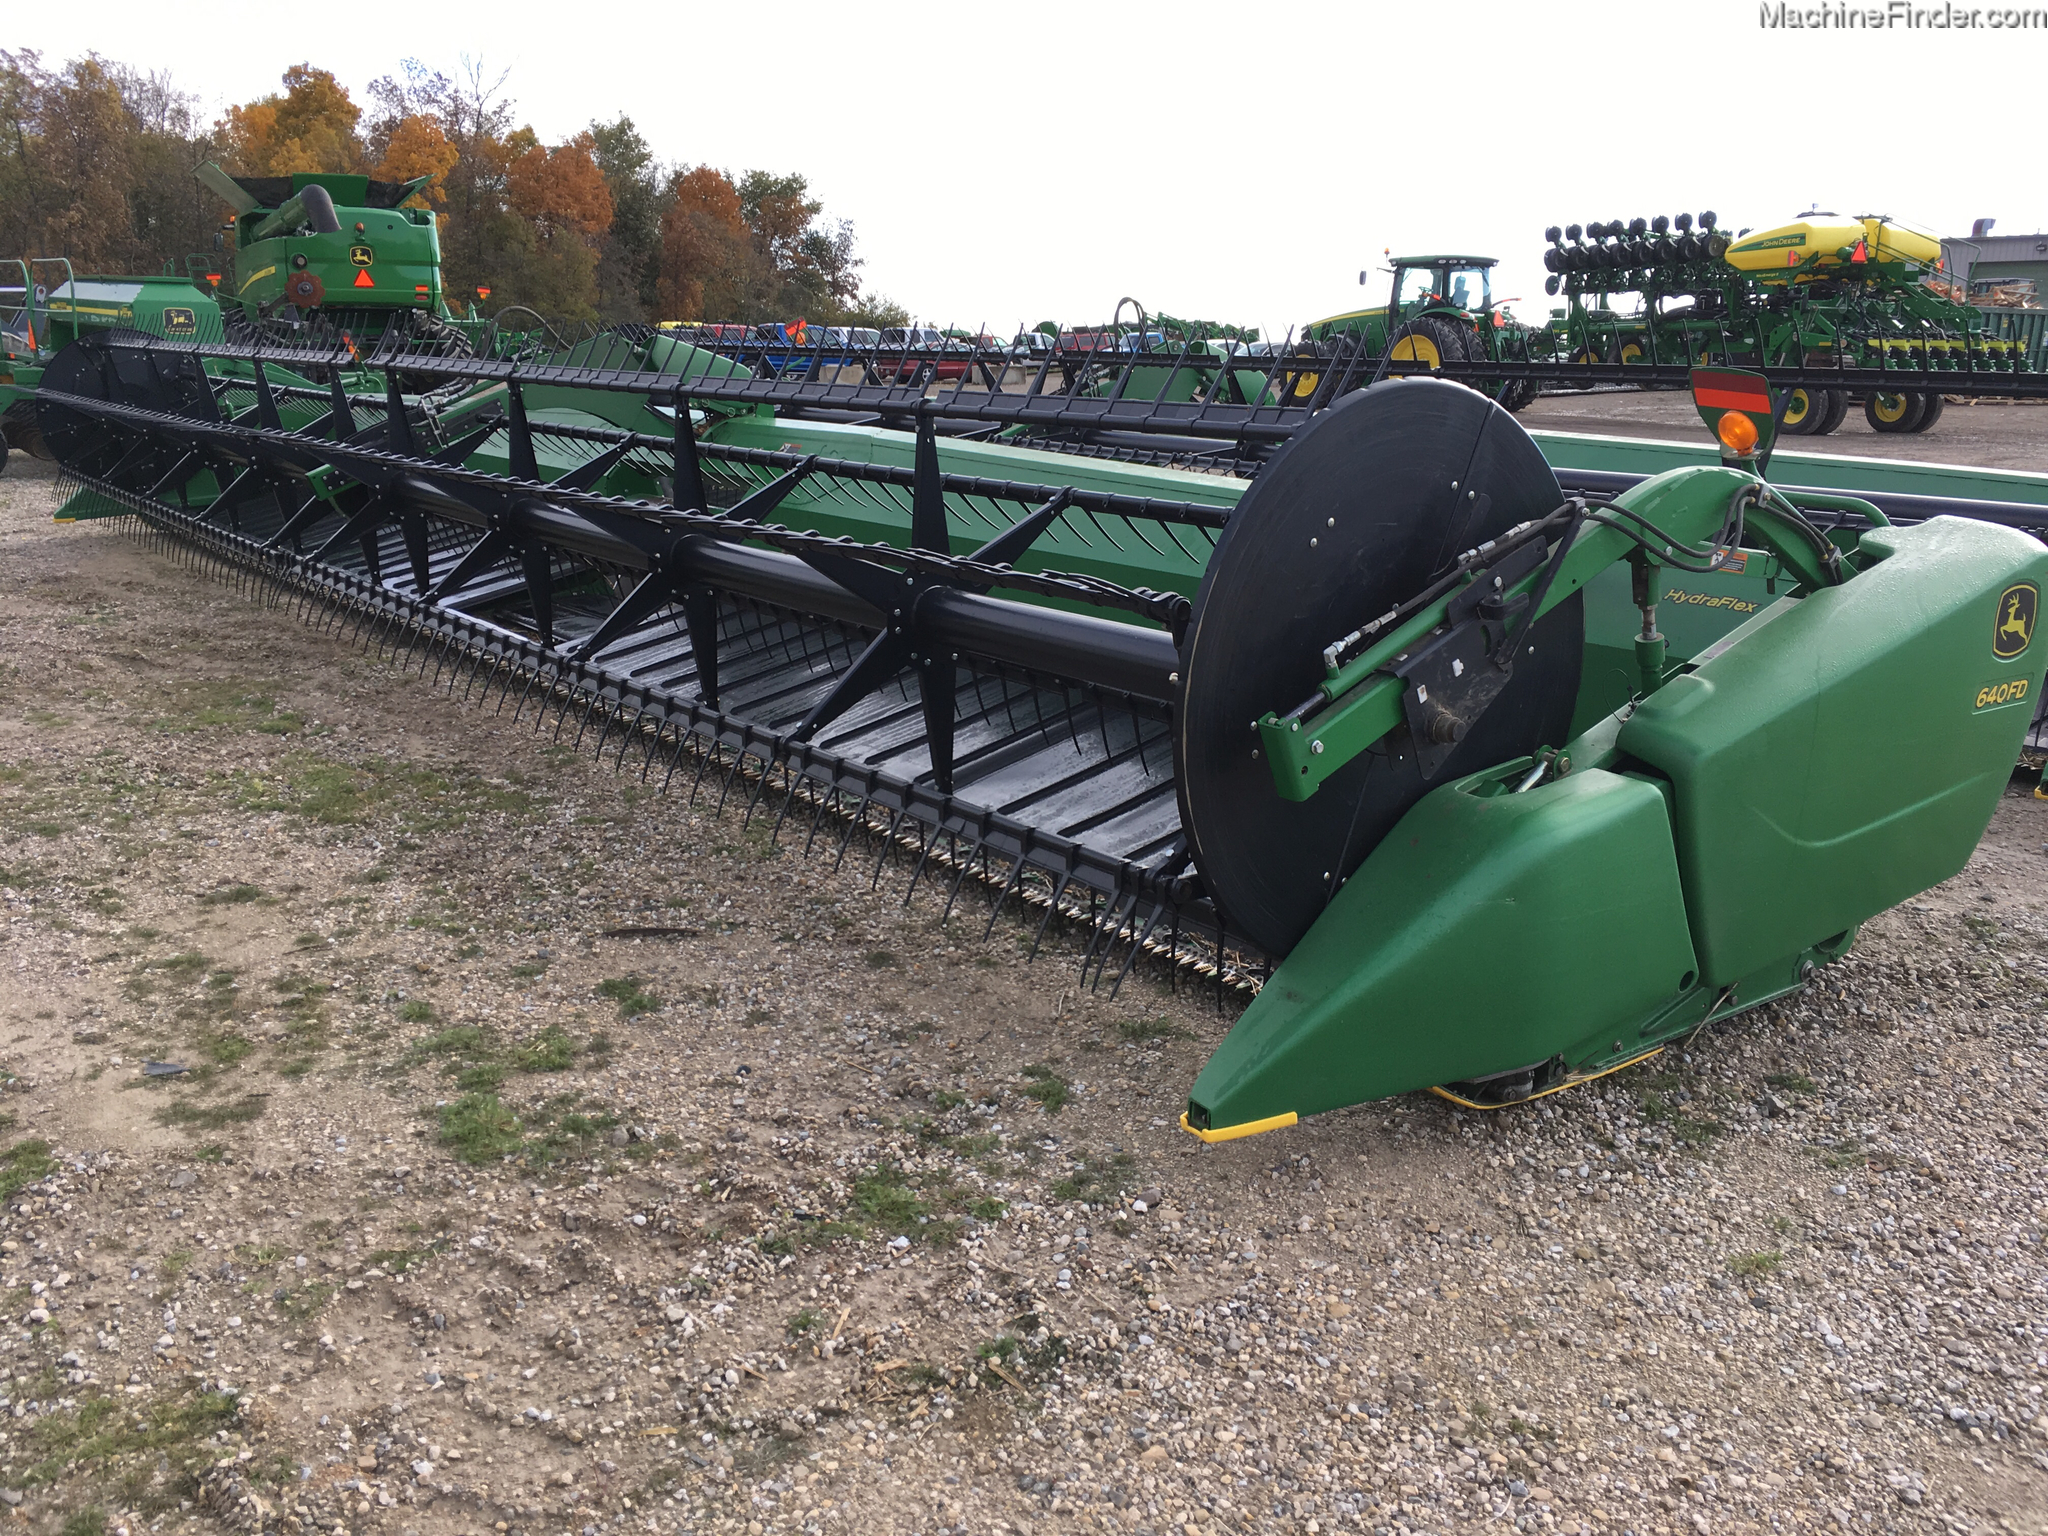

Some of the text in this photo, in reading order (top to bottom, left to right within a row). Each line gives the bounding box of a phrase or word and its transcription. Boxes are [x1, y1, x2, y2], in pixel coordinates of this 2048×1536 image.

[1779, 237, 1801, 246] DEERE
[1663, 588, 1758, 613] HydraFlex
[1976, 679, 2029, 708] 640FD
